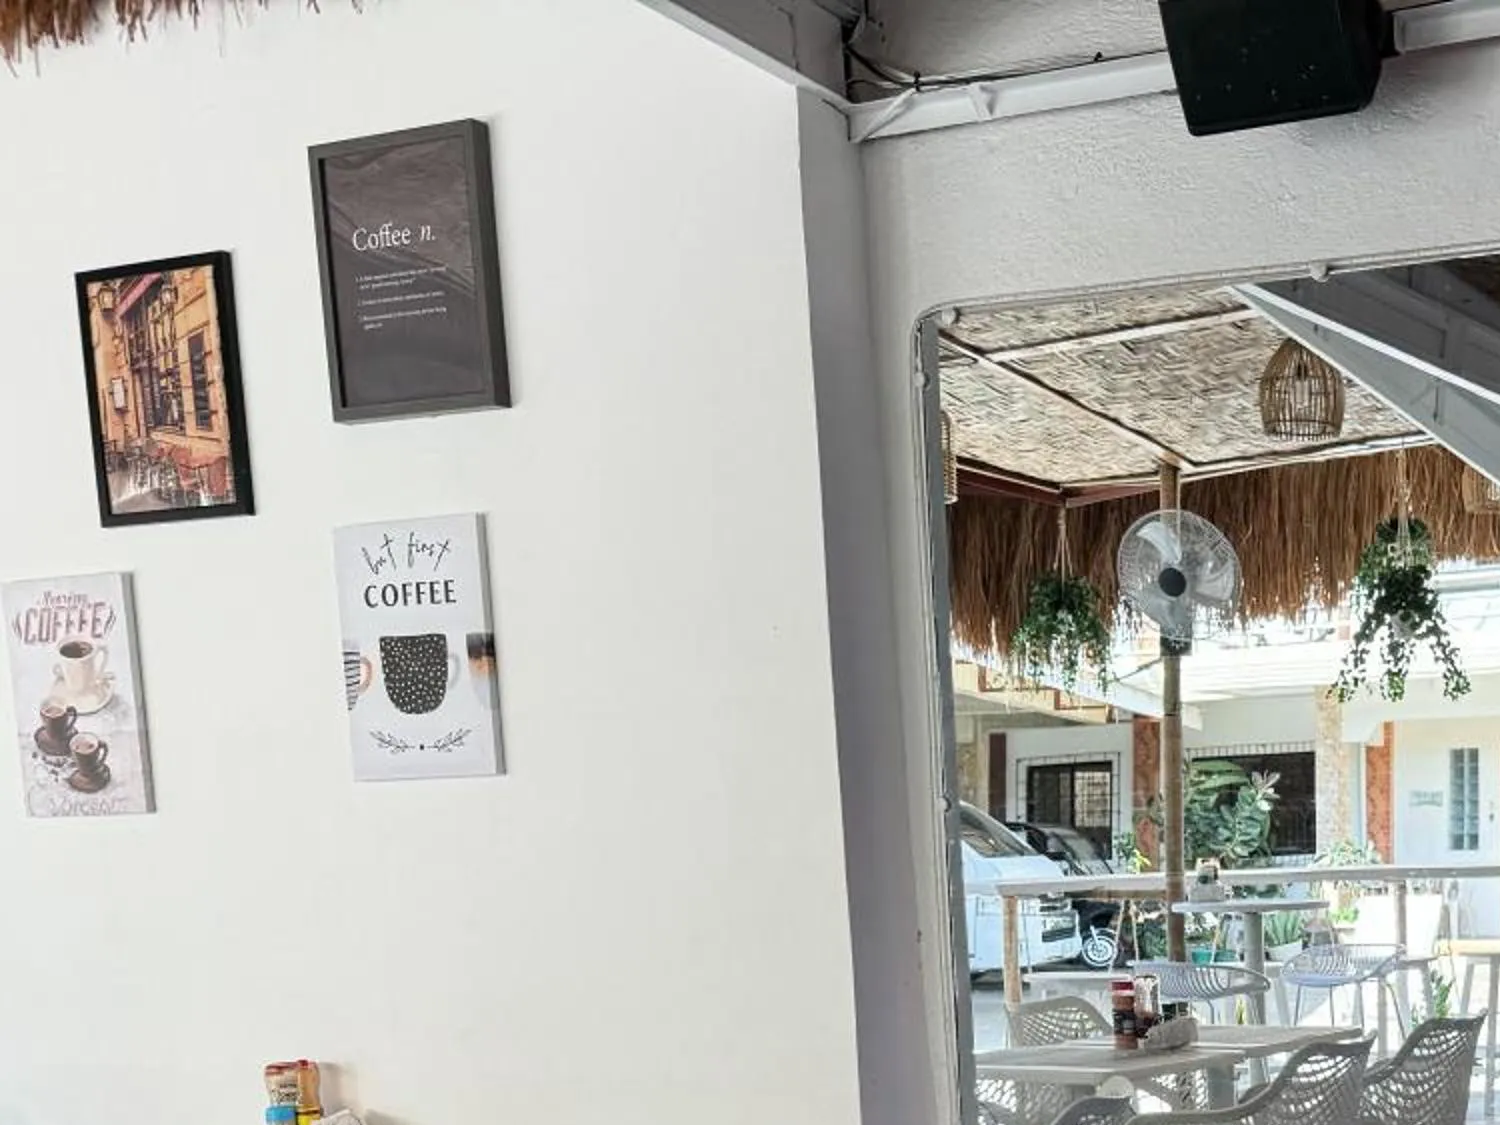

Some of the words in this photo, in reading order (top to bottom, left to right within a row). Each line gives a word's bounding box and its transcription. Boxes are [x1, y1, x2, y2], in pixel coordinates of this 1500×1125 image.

[352, 221, 412, 251] Coffee
[419, 225, 437, 241] n.
[361, 532, 397, 575] but
[407, 531, 452, 571] first
[363, 579, 457, 608] COFFEE
[23, 601, 107, 644] COFFEE
